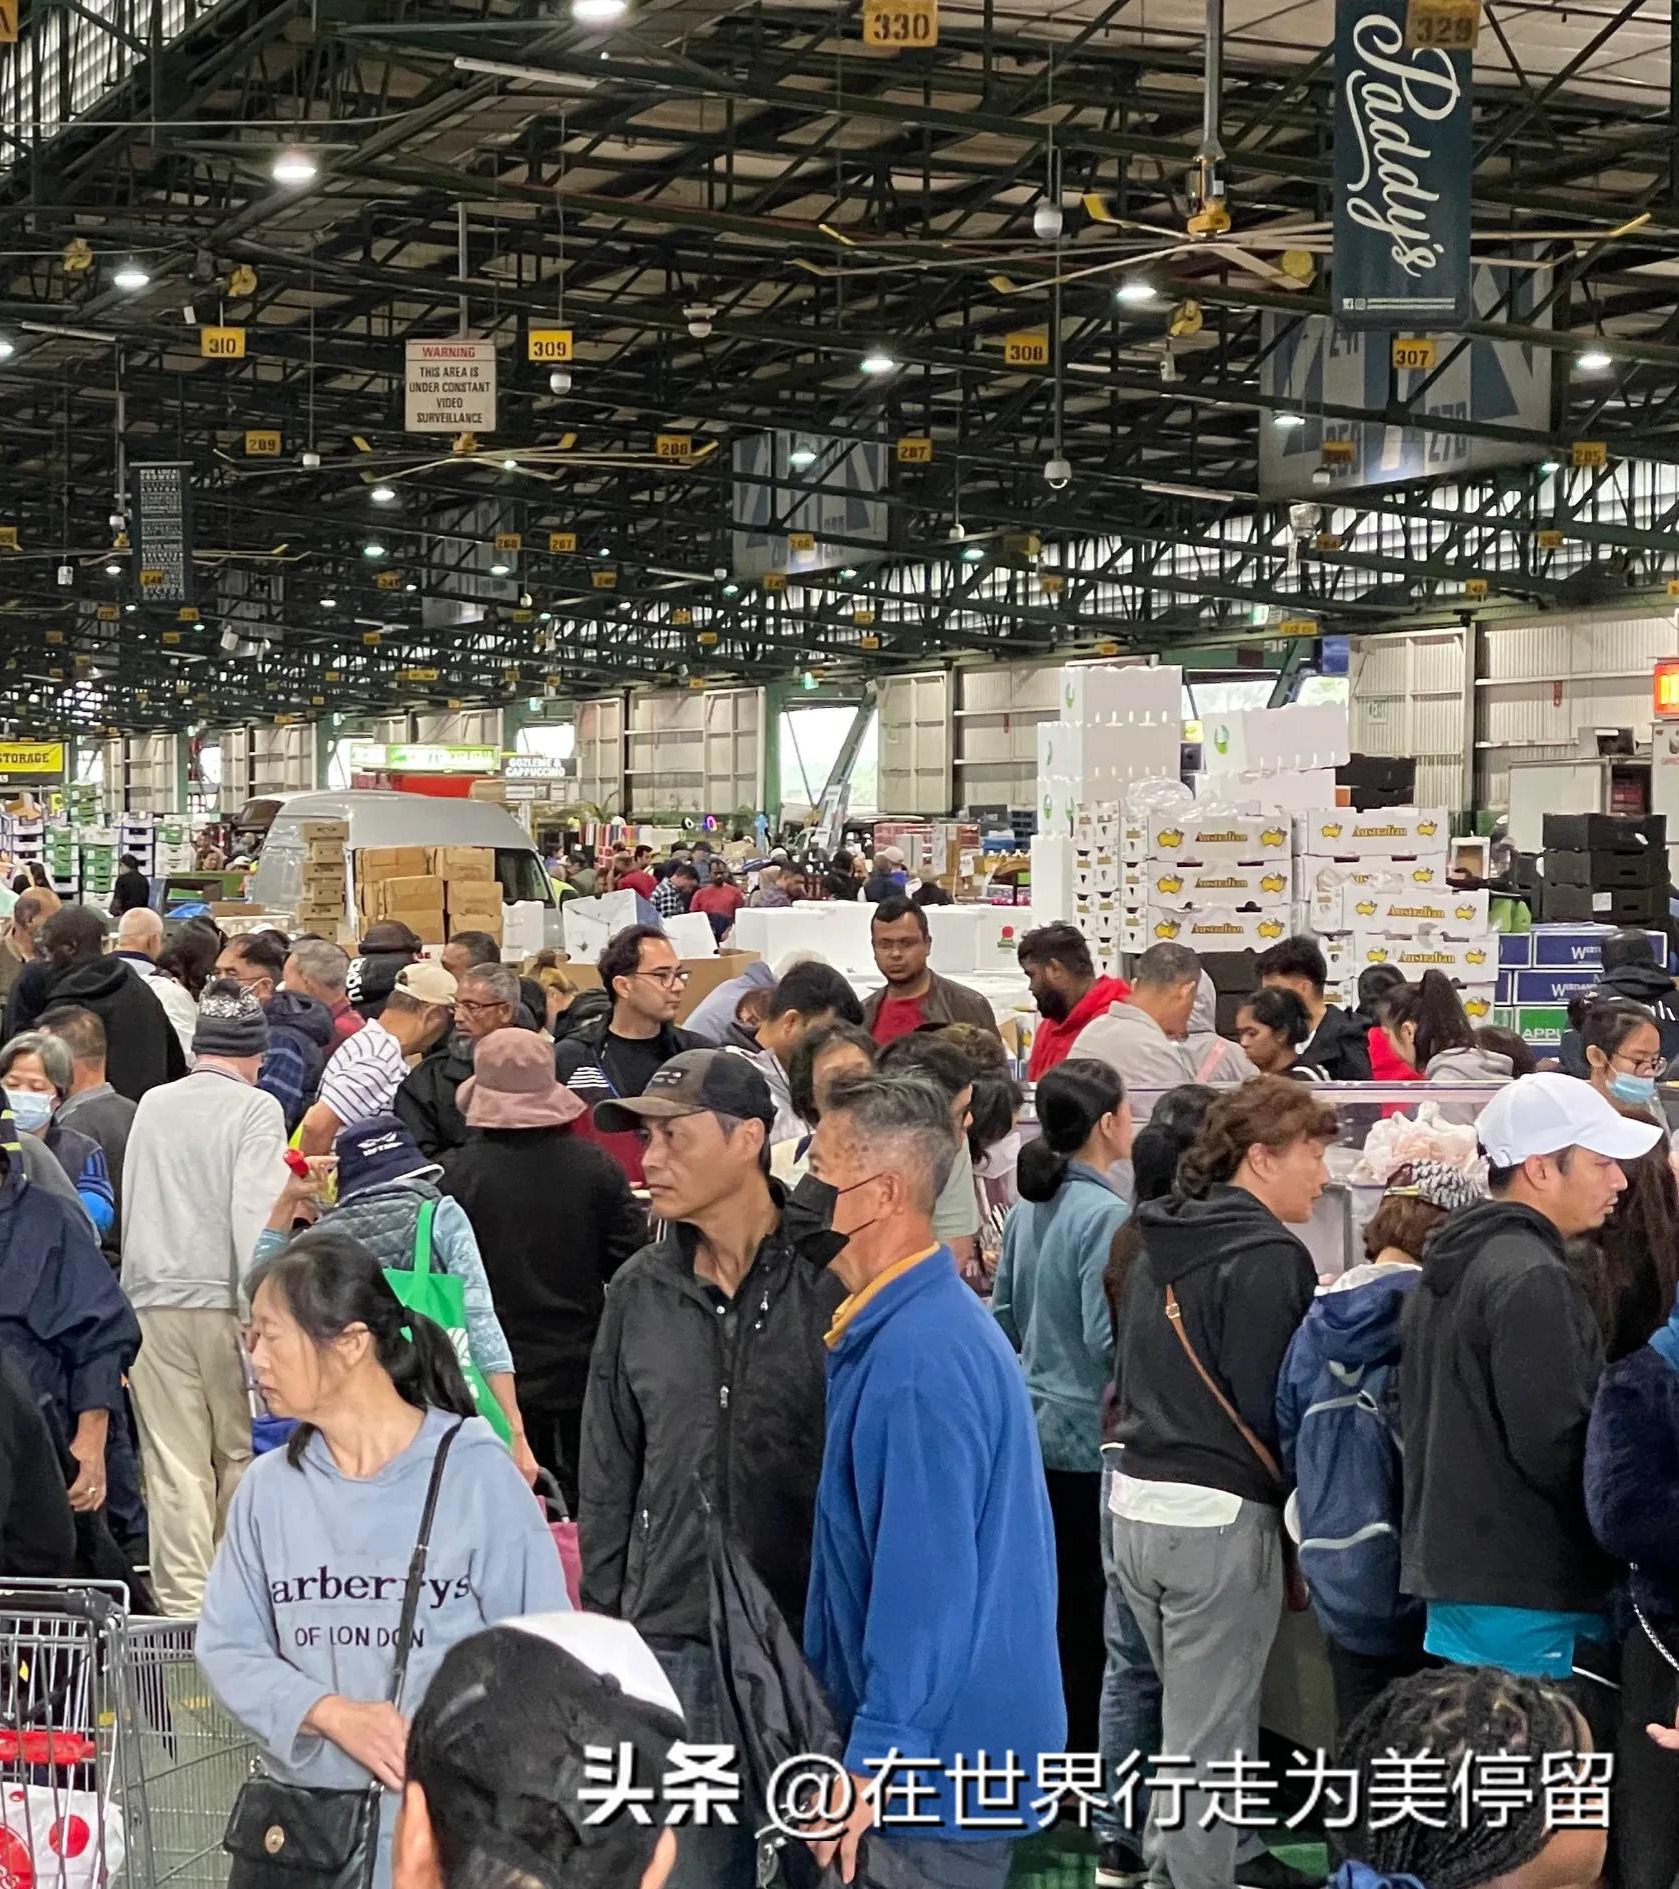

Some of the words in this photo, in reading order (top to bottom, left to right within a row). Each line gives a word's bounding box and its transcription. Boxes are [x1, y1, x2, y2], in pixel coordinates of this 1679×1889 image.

[874, 14, 929, 40] 330
[1416, 16, 1472, 44] 329
[1346, 14, 1460, 278] Paddy's
[209, 338, 236, 354] 310
[533, 342, 567, 358] 309
[422, 347, 475, 358] WARNING
[1010, 344, 1043, 361] 308
[1395, 349, 1429, 365] 307
[420, 367, 440, 377] THIS
[443, 367, 467, 377] AREA
[470, 367, 479, 377] IS
[409, 382, 440, 392] UNDER
[442, 382, 490, 392] CONSTANT
[437, 398, 463, 408] VIDEO
[417, 413, 483, 424] SURVEILLANCE
[505, 767, 565, 777] CAPPUCCINO
[1195, 831, 1248, 843] Australian
[1352, 825, 1407, 837] Australian
[1195, 877, 1248, 888] Australian
[1387, 905, 1445, 918] Australian
[1192, 923, 1244, 934] Australian
[1398, 952, 1455, 964] Australian
[272, 1565, 471, 1609] arberys
[295, 1627, 321, 1647] OF
